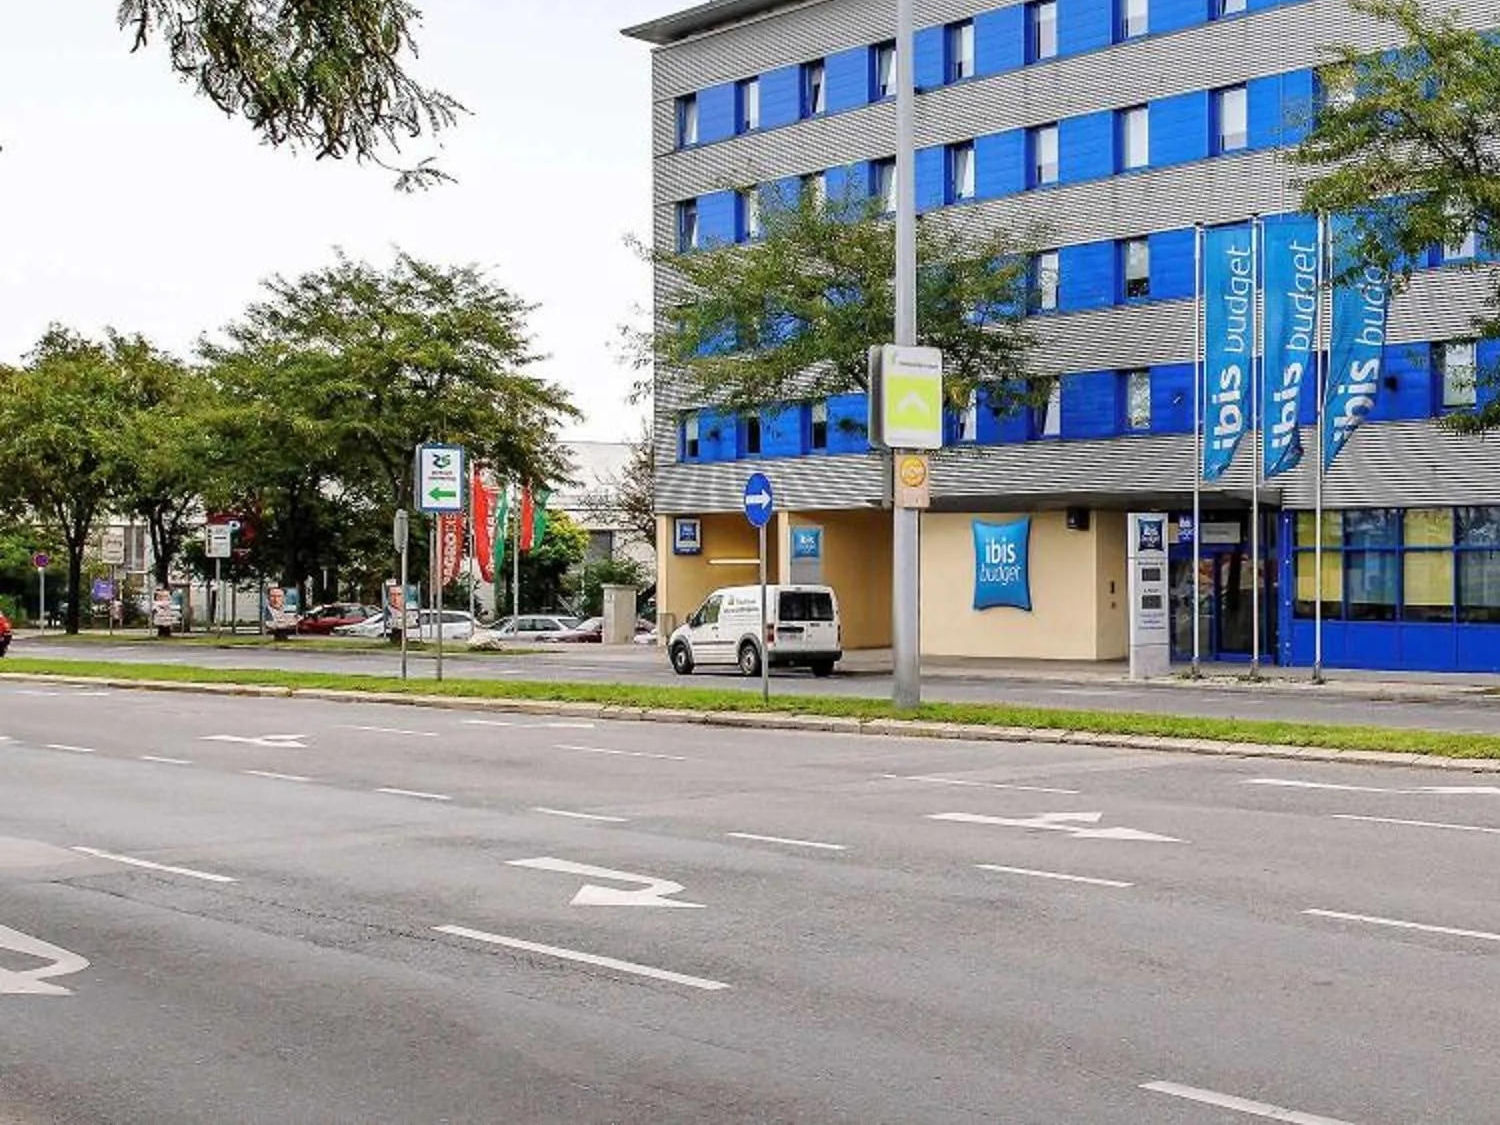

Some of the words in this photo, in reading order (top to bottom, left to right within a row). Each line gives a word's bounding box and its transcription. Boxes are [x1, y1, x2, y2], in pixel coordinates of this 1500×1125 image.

[1223, 244, 1252, 353] budget
[1285, 239, 1317, 352] budget
[1353, 263, 1391, 347] budg
[1211, 364, 1242, 451] ibis
[1271, 362, 1304, 450] ibis
[979, 562, 1022, 587] budget
[985, 536, 1016, 564] ibis
